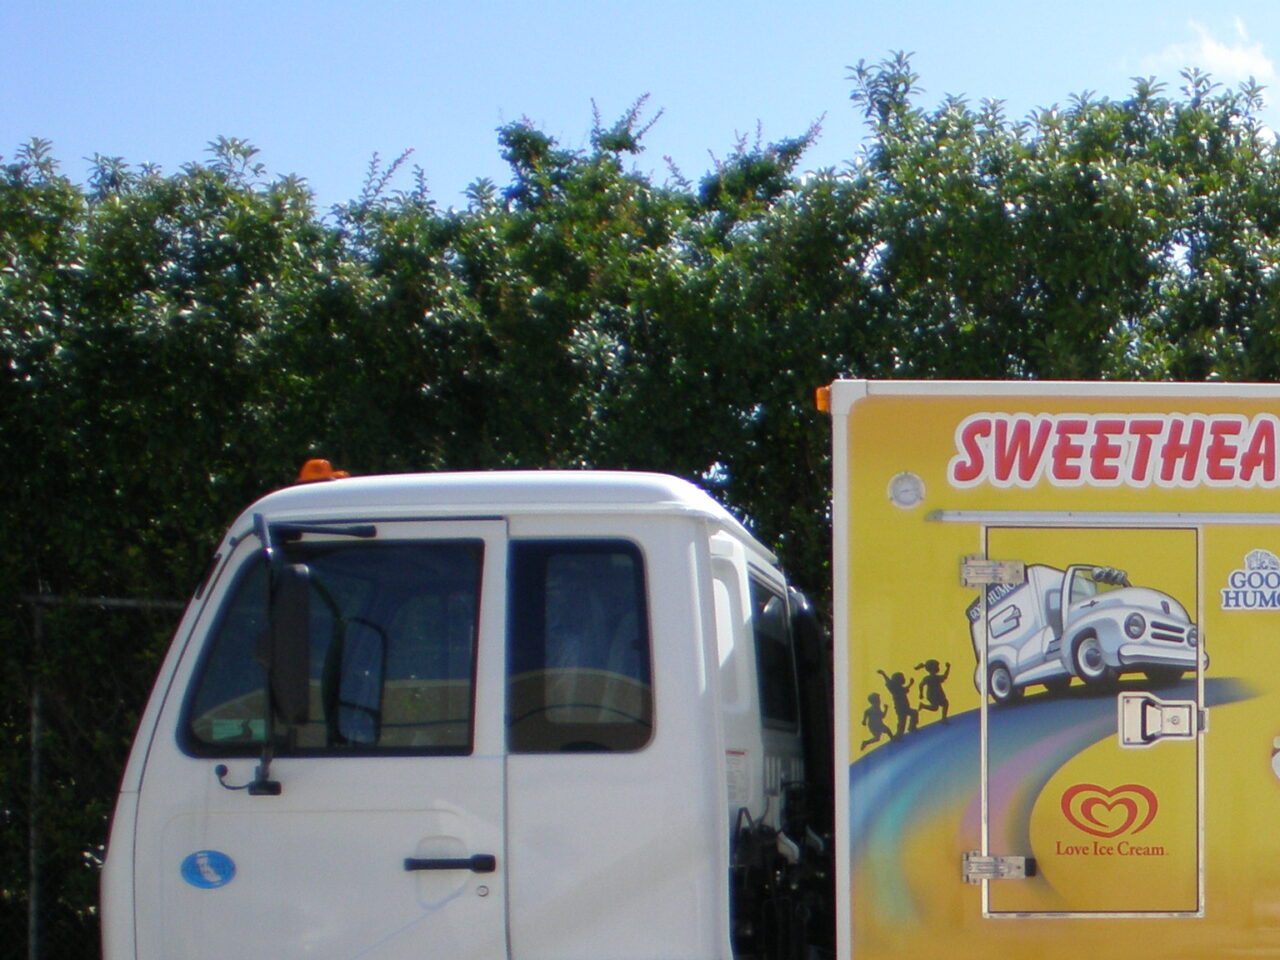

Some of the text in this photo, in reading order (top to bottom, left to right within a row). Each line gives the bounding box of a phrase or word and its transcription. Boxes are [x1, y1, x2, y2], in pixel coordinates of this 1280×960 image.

[1056, 841, 1165, 856] Love Ice Cream
